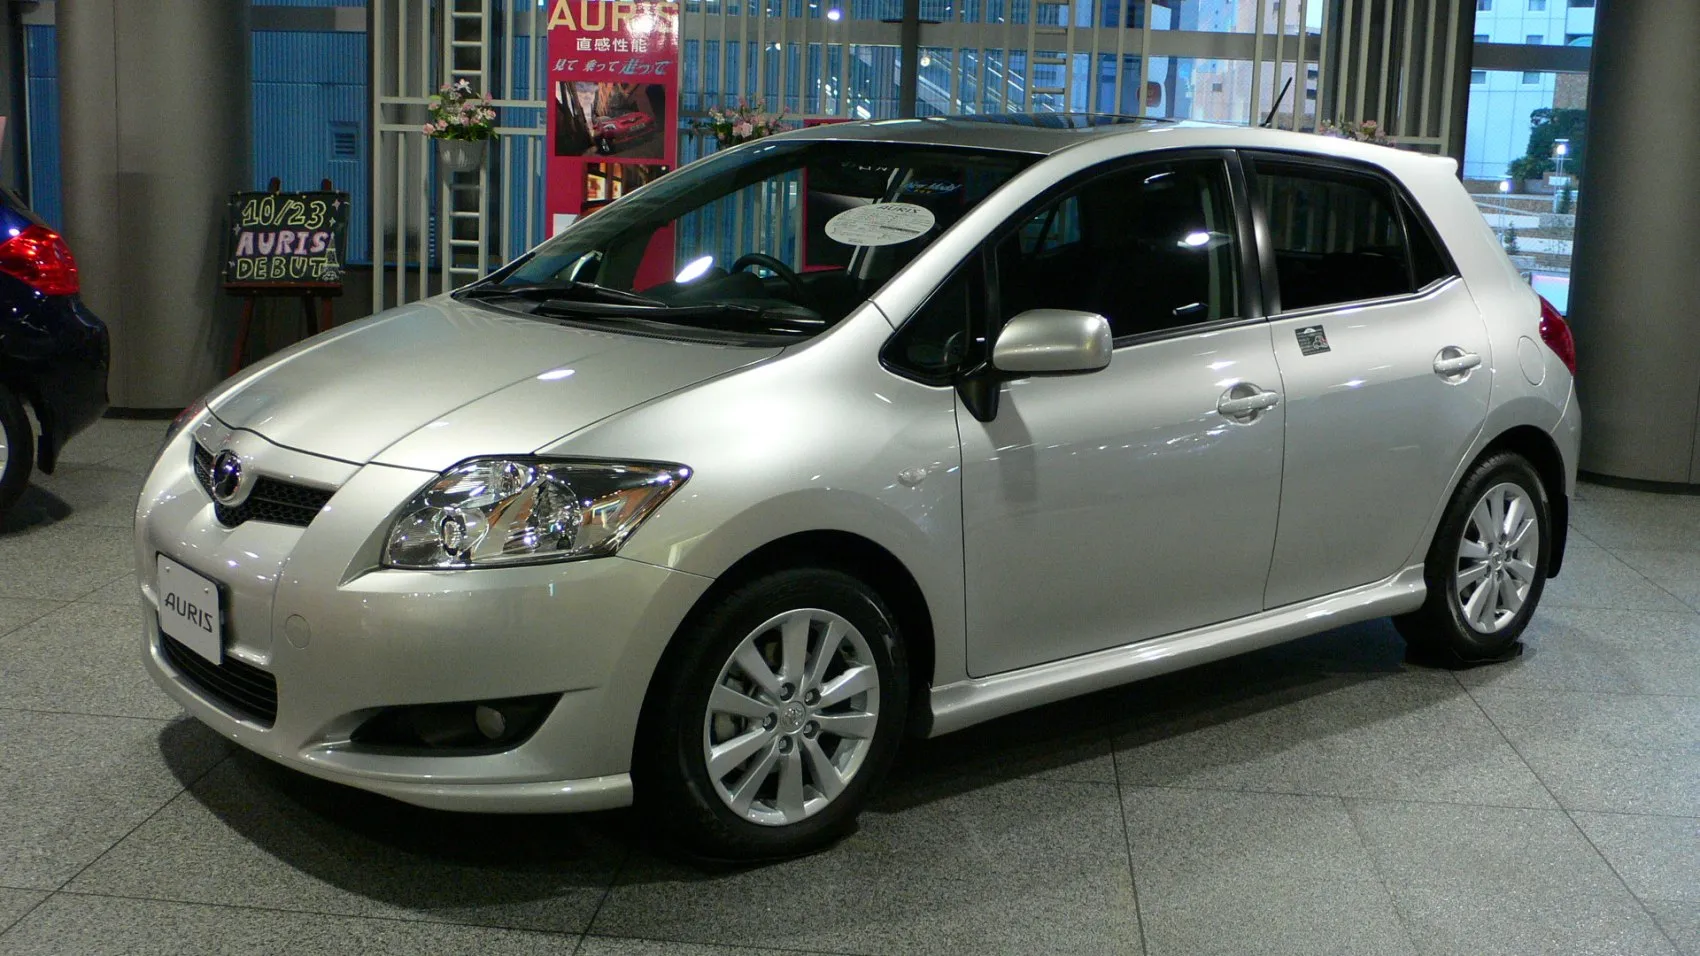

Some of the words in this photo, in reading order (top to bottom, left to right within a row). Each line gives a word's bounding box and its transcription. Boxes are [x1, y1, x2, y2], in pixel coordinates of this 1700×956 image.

[576, 37, 648, 53] 直感性能
[552, 58, 579, 72] 見て
[583, 59, 620, 73] 乗って
[241, 196, 327, 230] 10/23
[235, 230, 330, 257] AURIS
[236, 256, 328, 280] DEBUT
[165, 592, 213, 633] AURIS
